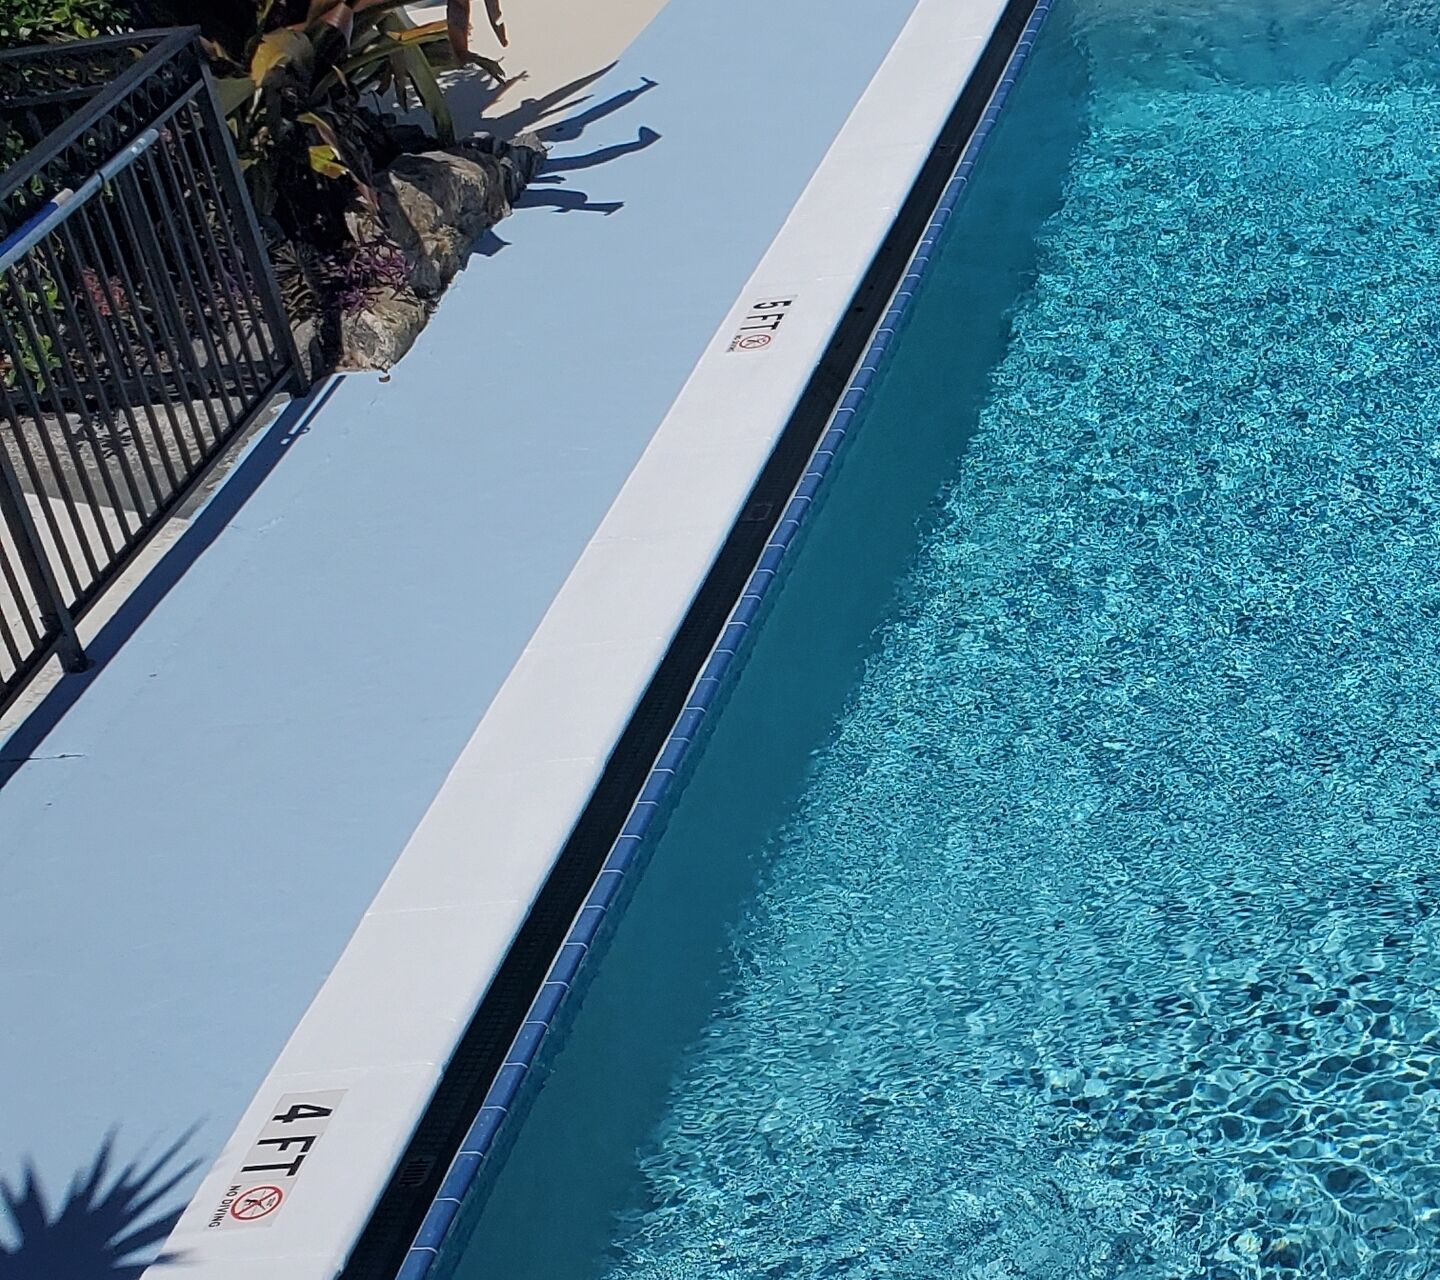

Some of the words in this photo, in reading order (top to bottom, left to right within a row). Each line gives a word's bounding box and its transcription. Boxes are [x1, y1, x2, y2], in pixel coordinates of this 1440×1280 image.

[753, 300, 792, 309] 5
[740, 313, 784, 330] FT
[272, 1104, 333, 1123] 4
[240, 1135, 317, 1176] FT
[226, 1185, 242, 1197] NO
[208, 1199, 234, 1227] DIVING
